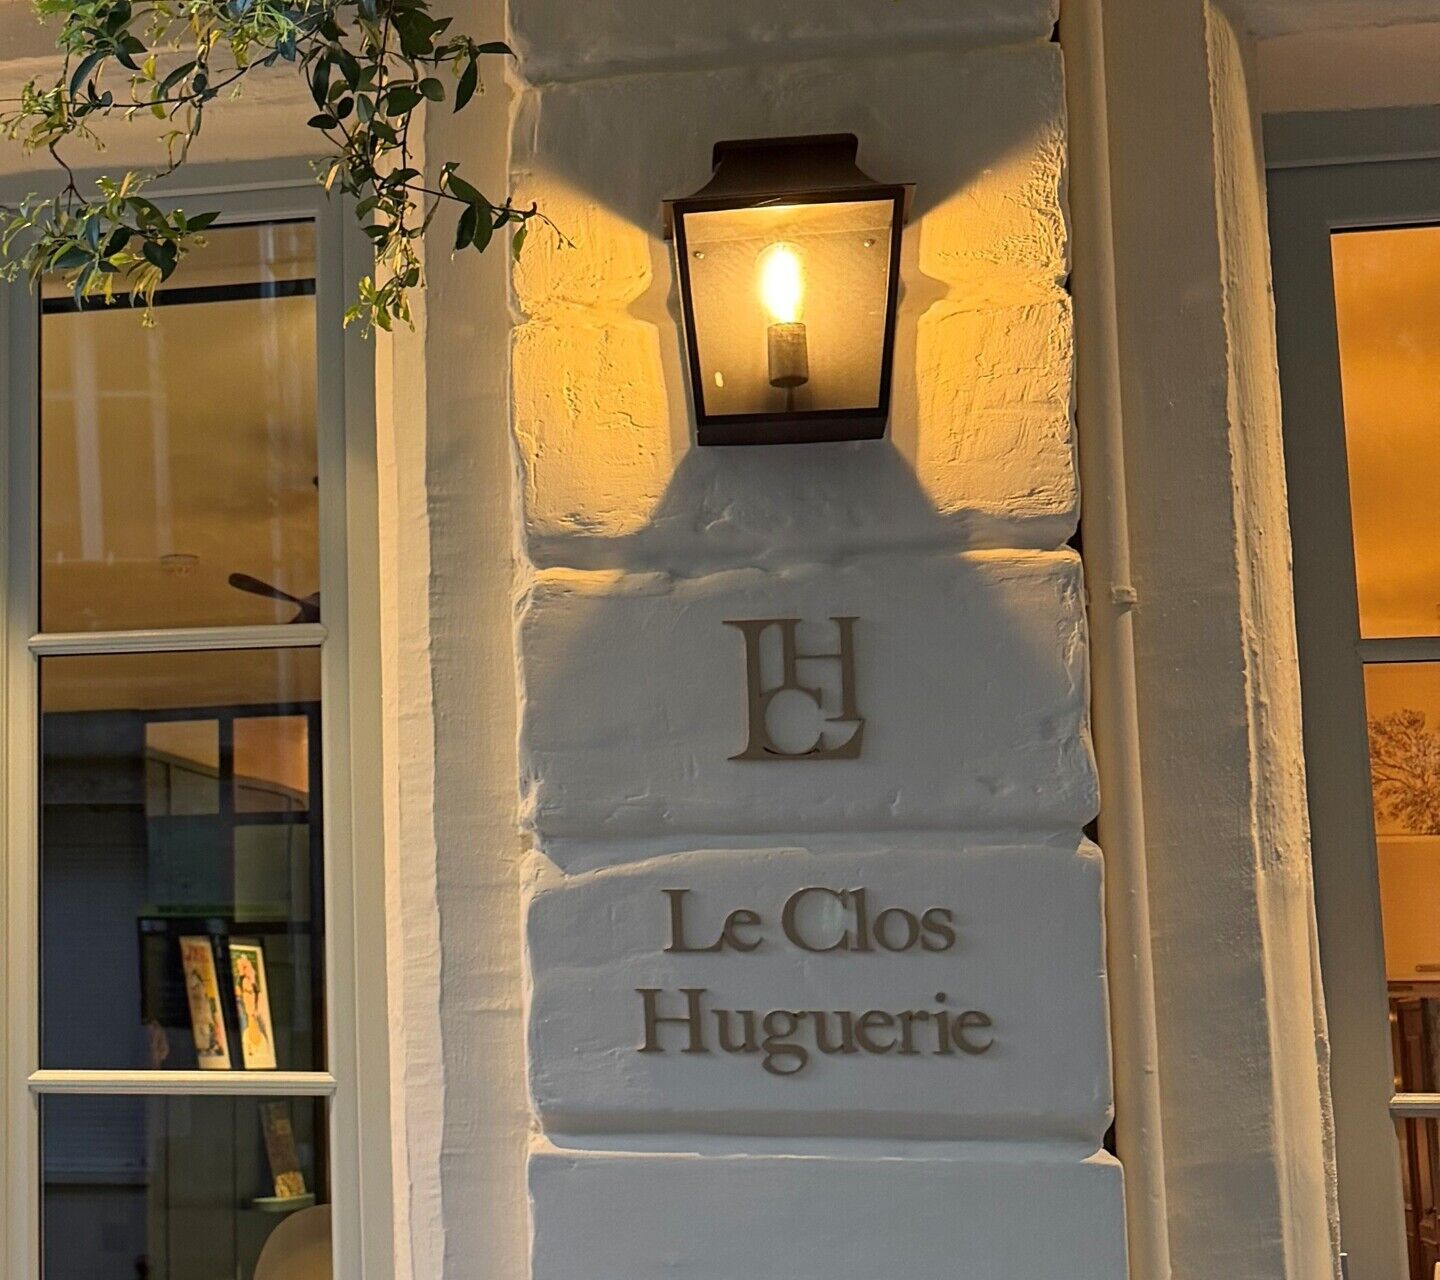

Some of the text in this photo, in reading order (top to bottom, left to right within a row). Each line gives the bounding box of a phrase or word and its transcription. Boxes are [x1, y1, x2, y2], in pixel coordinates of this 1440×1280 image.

[661, 887, 957, 954] Le Clos
[635, 988, 994, 1076] Huguerie
